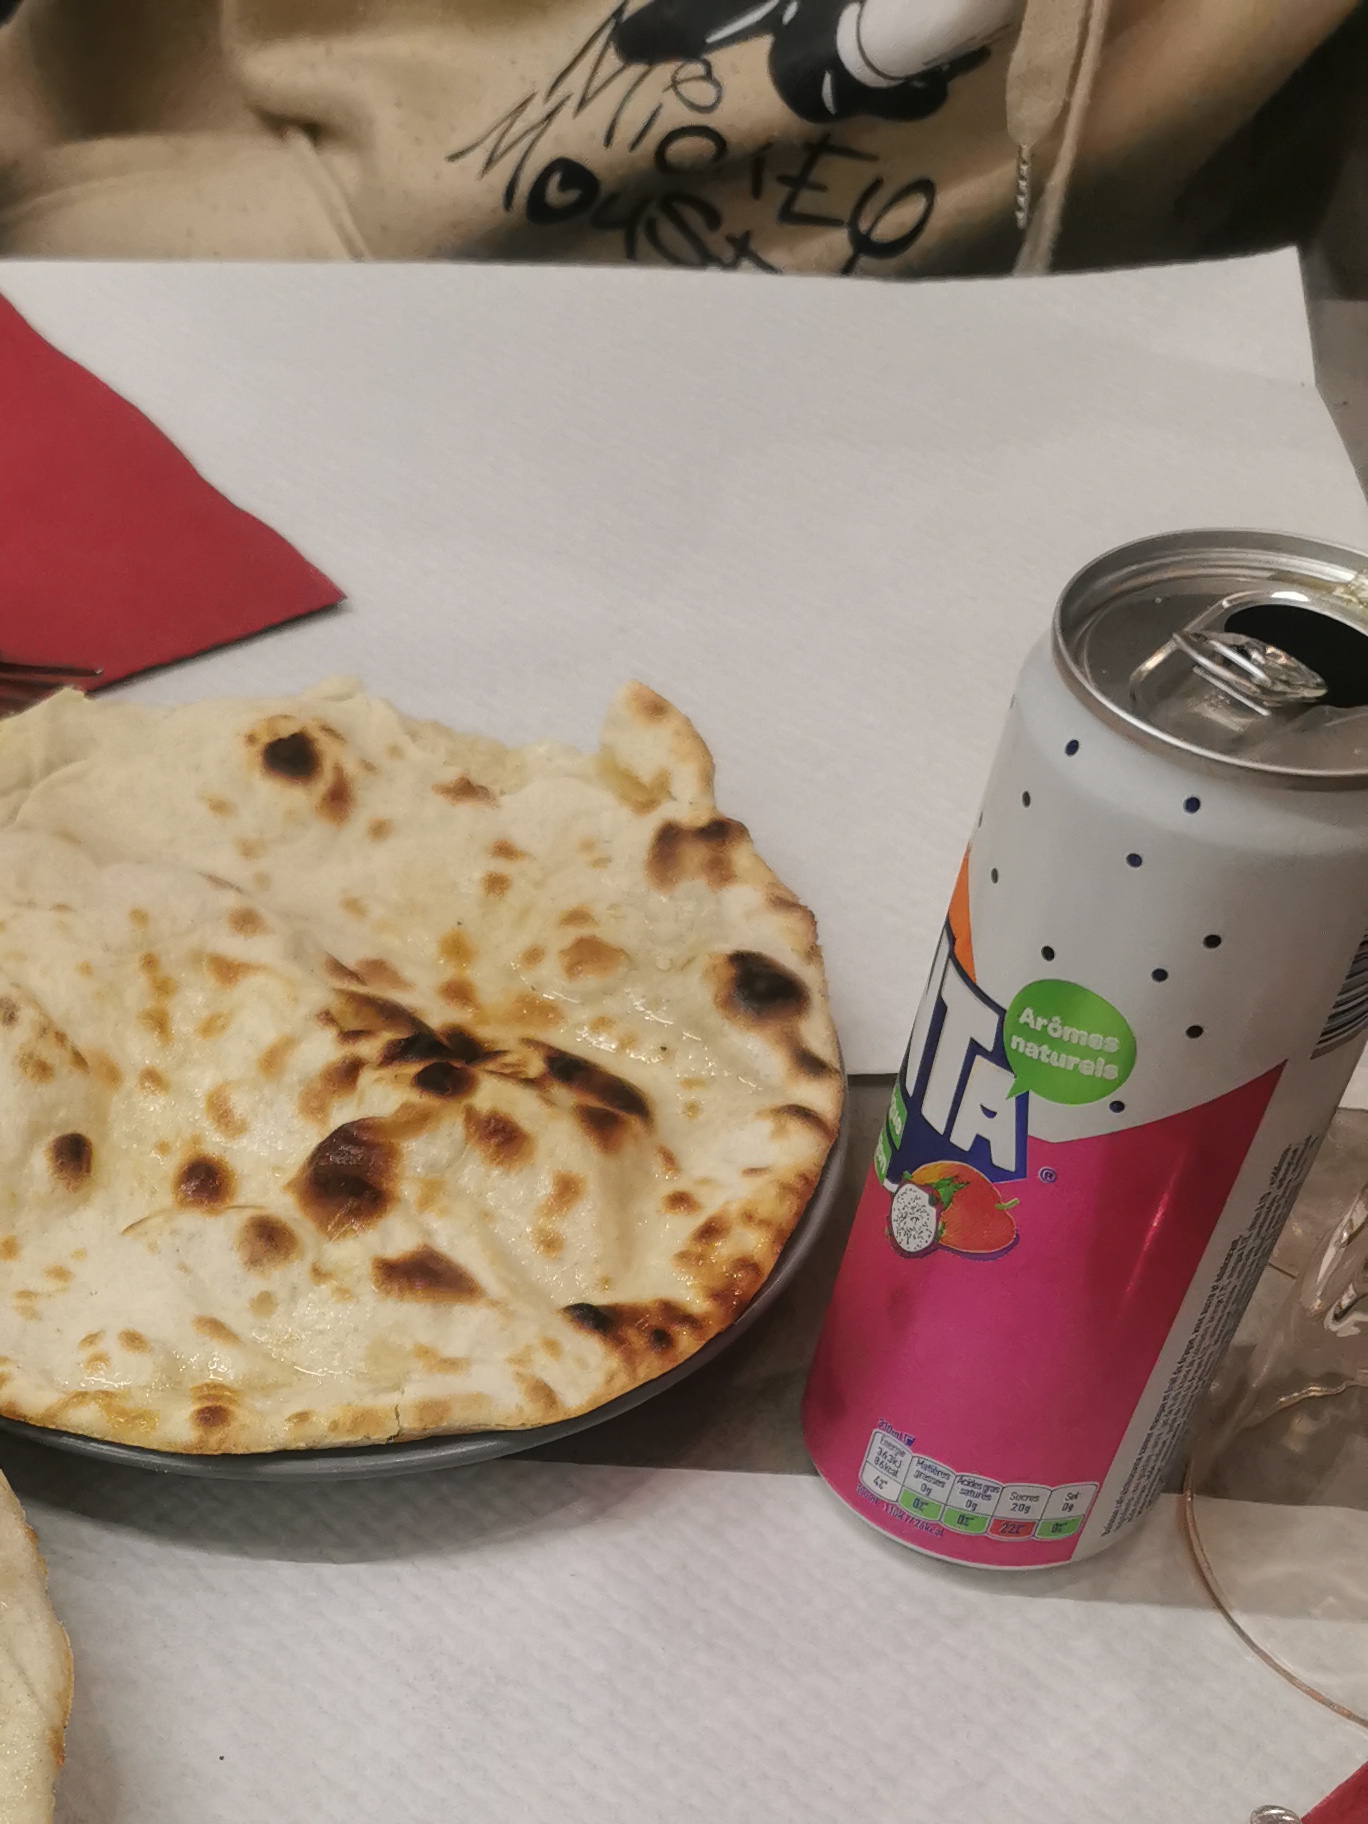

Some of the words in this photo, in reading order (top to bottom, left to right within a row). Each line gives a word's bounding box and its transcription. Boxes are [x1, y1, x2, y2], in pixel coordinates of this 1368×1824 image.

[1018, 1006, 1121, 1053] Arômes
[1010, 1033, 1120, 1081] naturels
[1009, 1491, 1041, 1503] Sucres
[1010, 1502, 1032, 1514] 20g
